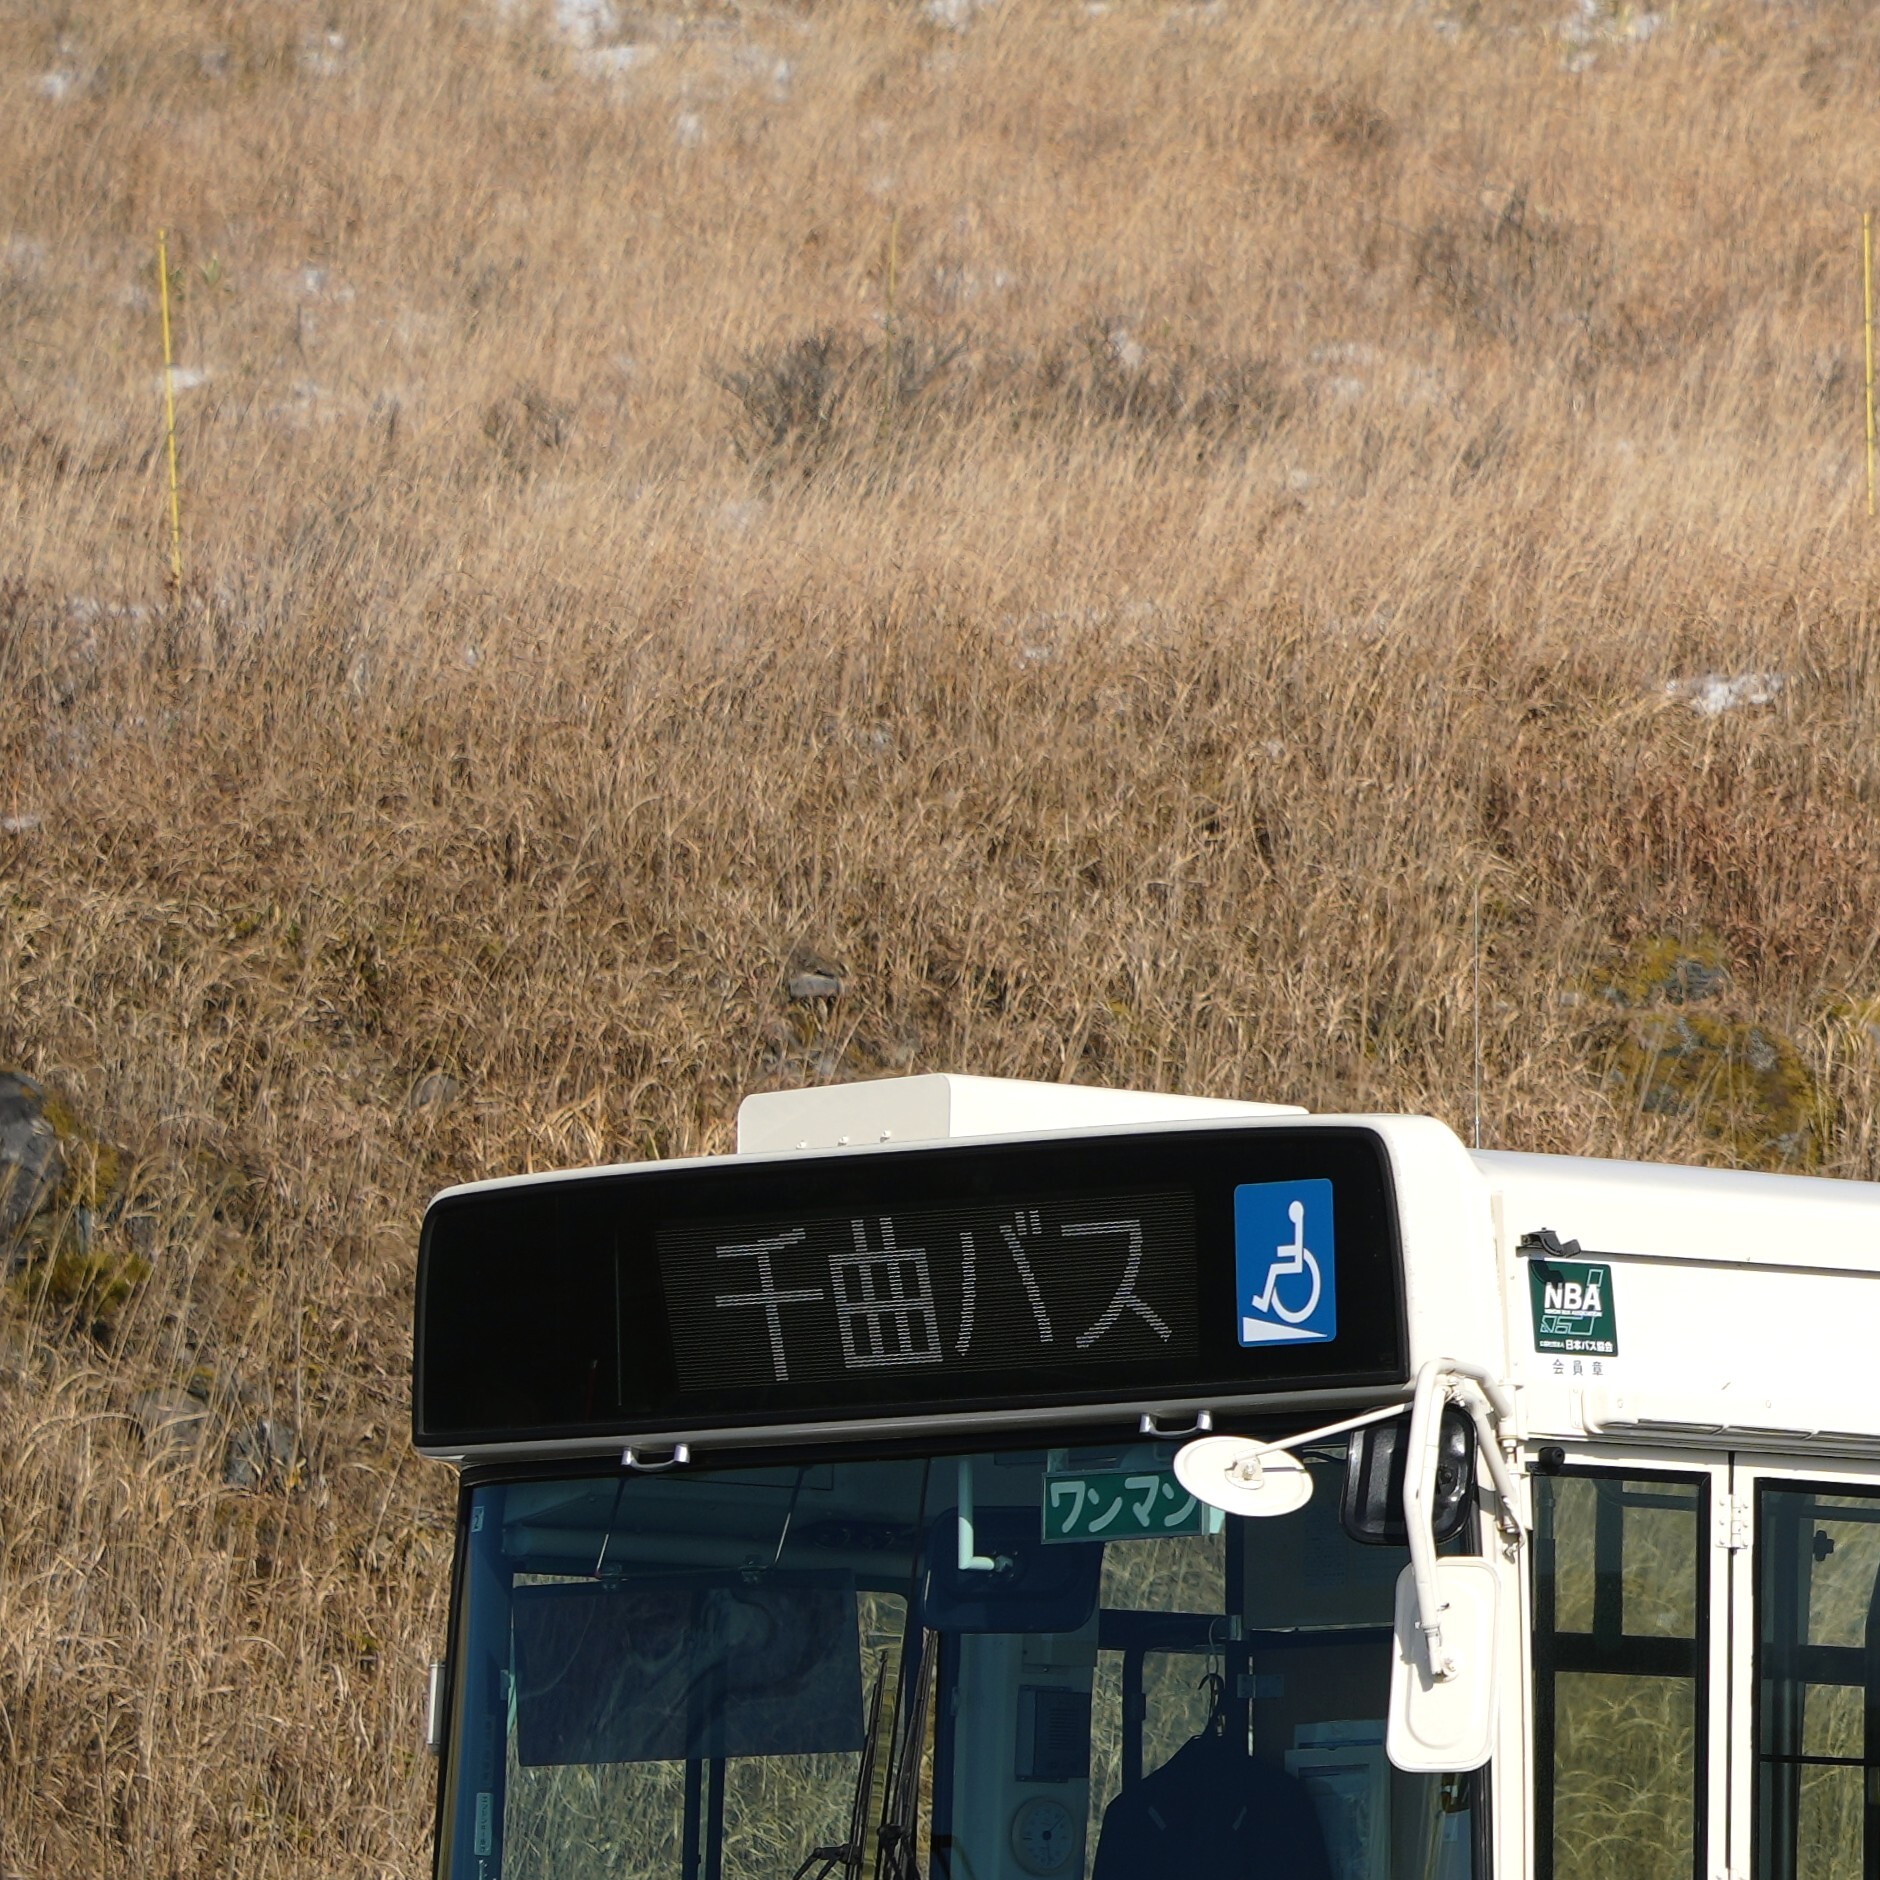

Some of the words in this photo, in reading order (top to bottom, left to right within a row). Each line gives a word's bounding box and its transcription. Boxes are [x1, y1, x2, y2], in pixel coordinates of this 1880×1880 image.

[715, 1209, 1173, 1382] 千曲バス
[1544, 1282, 1602, 1310] NBA
